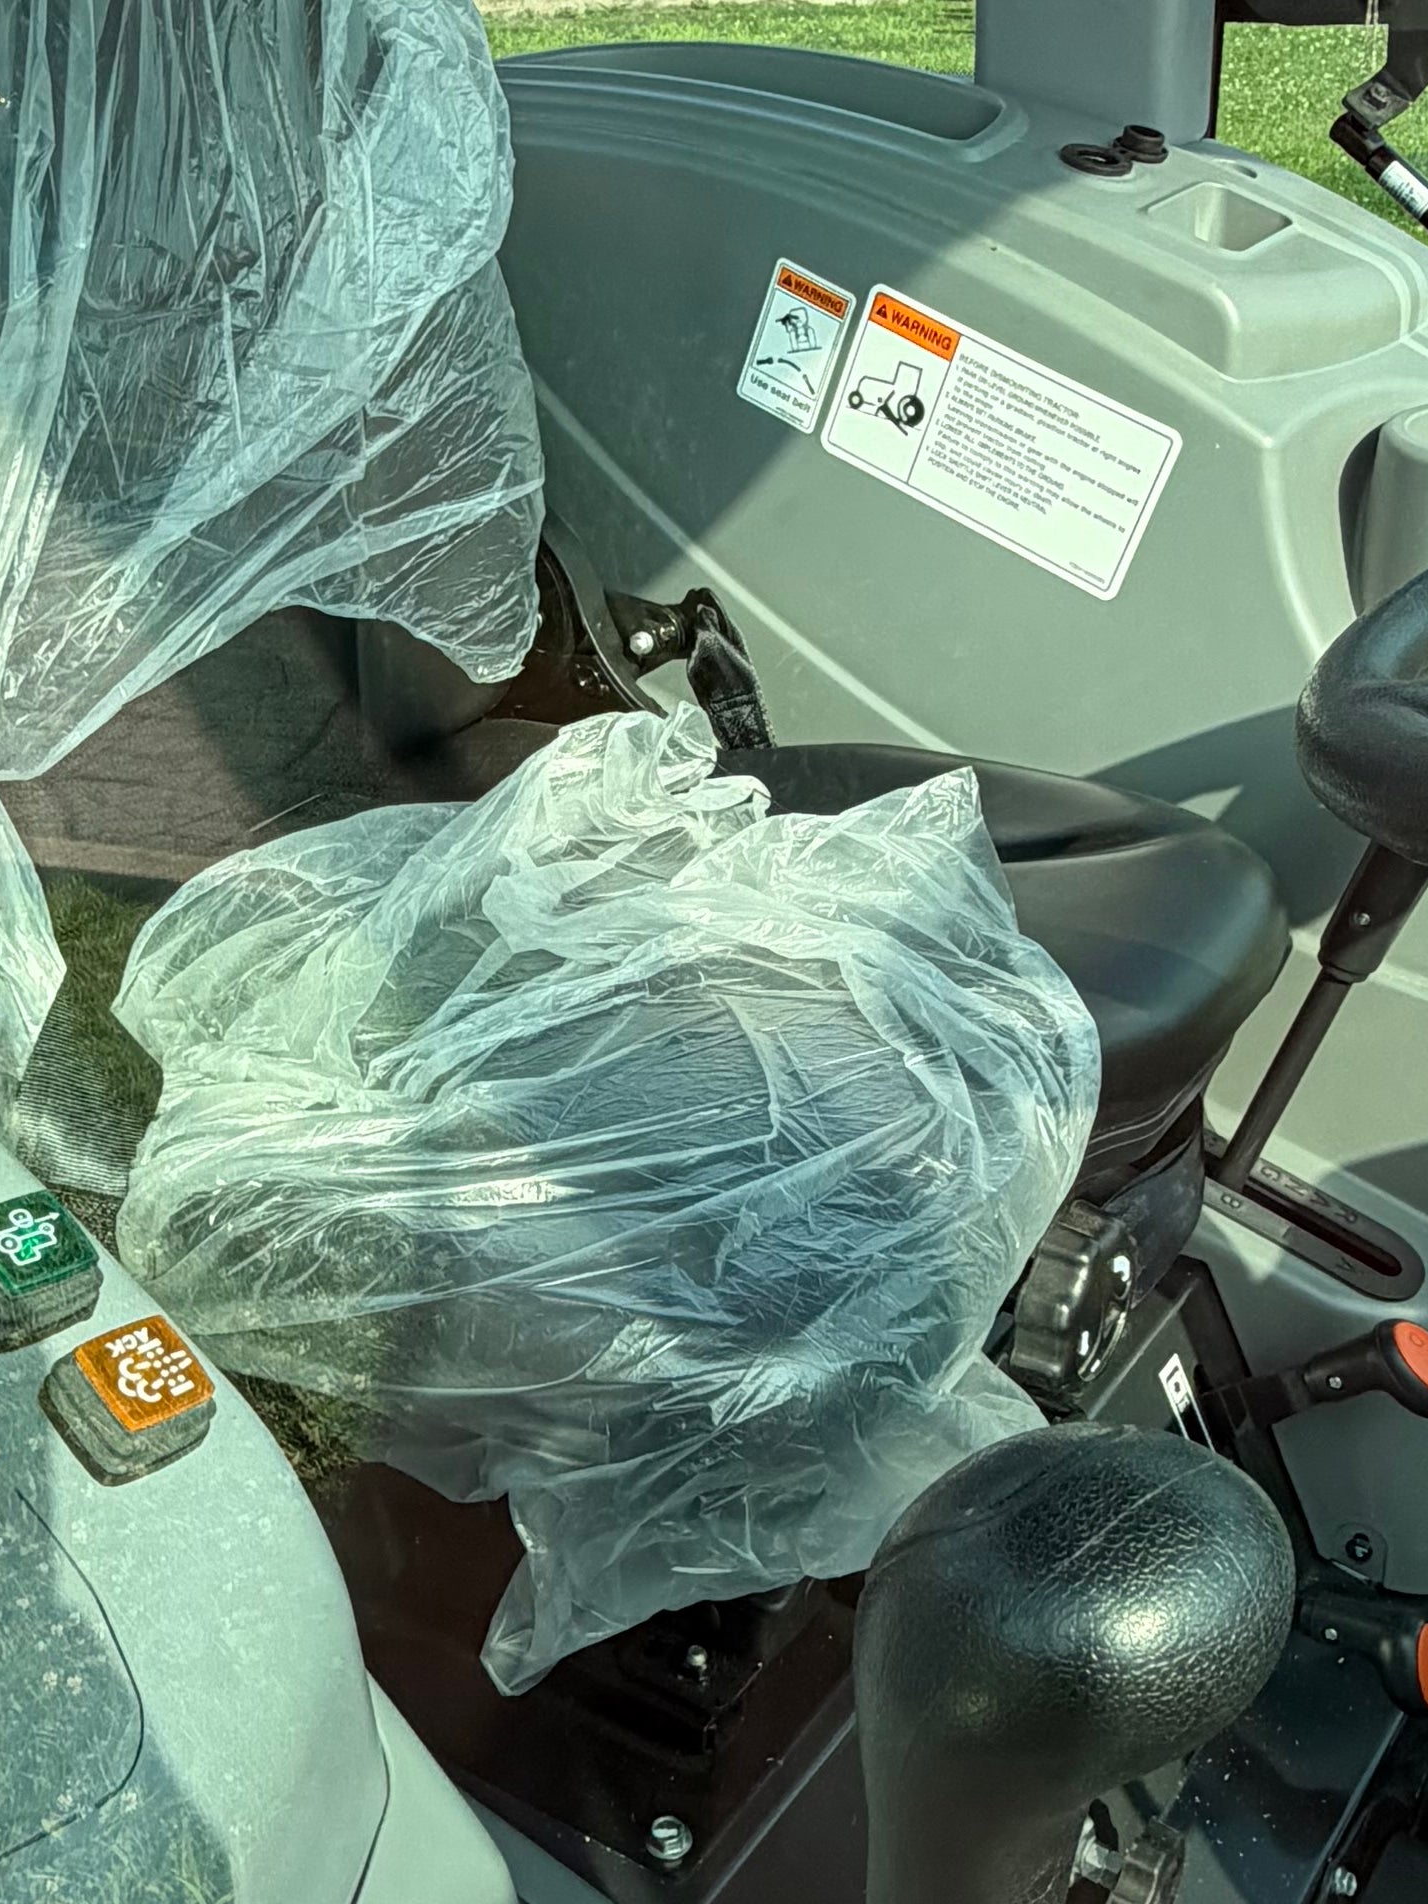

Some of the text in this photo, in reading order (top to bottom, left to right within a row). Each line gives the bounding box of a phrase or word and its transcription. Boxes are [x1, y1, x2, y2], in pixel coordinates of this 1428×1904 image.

[792, 277, 844, 315] WARNING
[889, 308, 953, 353] WARNING
[749, 372, 811, 414] Use seat belt
[1221, 1192, 1242, 1209] B
[1260, 1166, 1358, 1224] RANG
[105, 1327, 149, 1358] ACK
